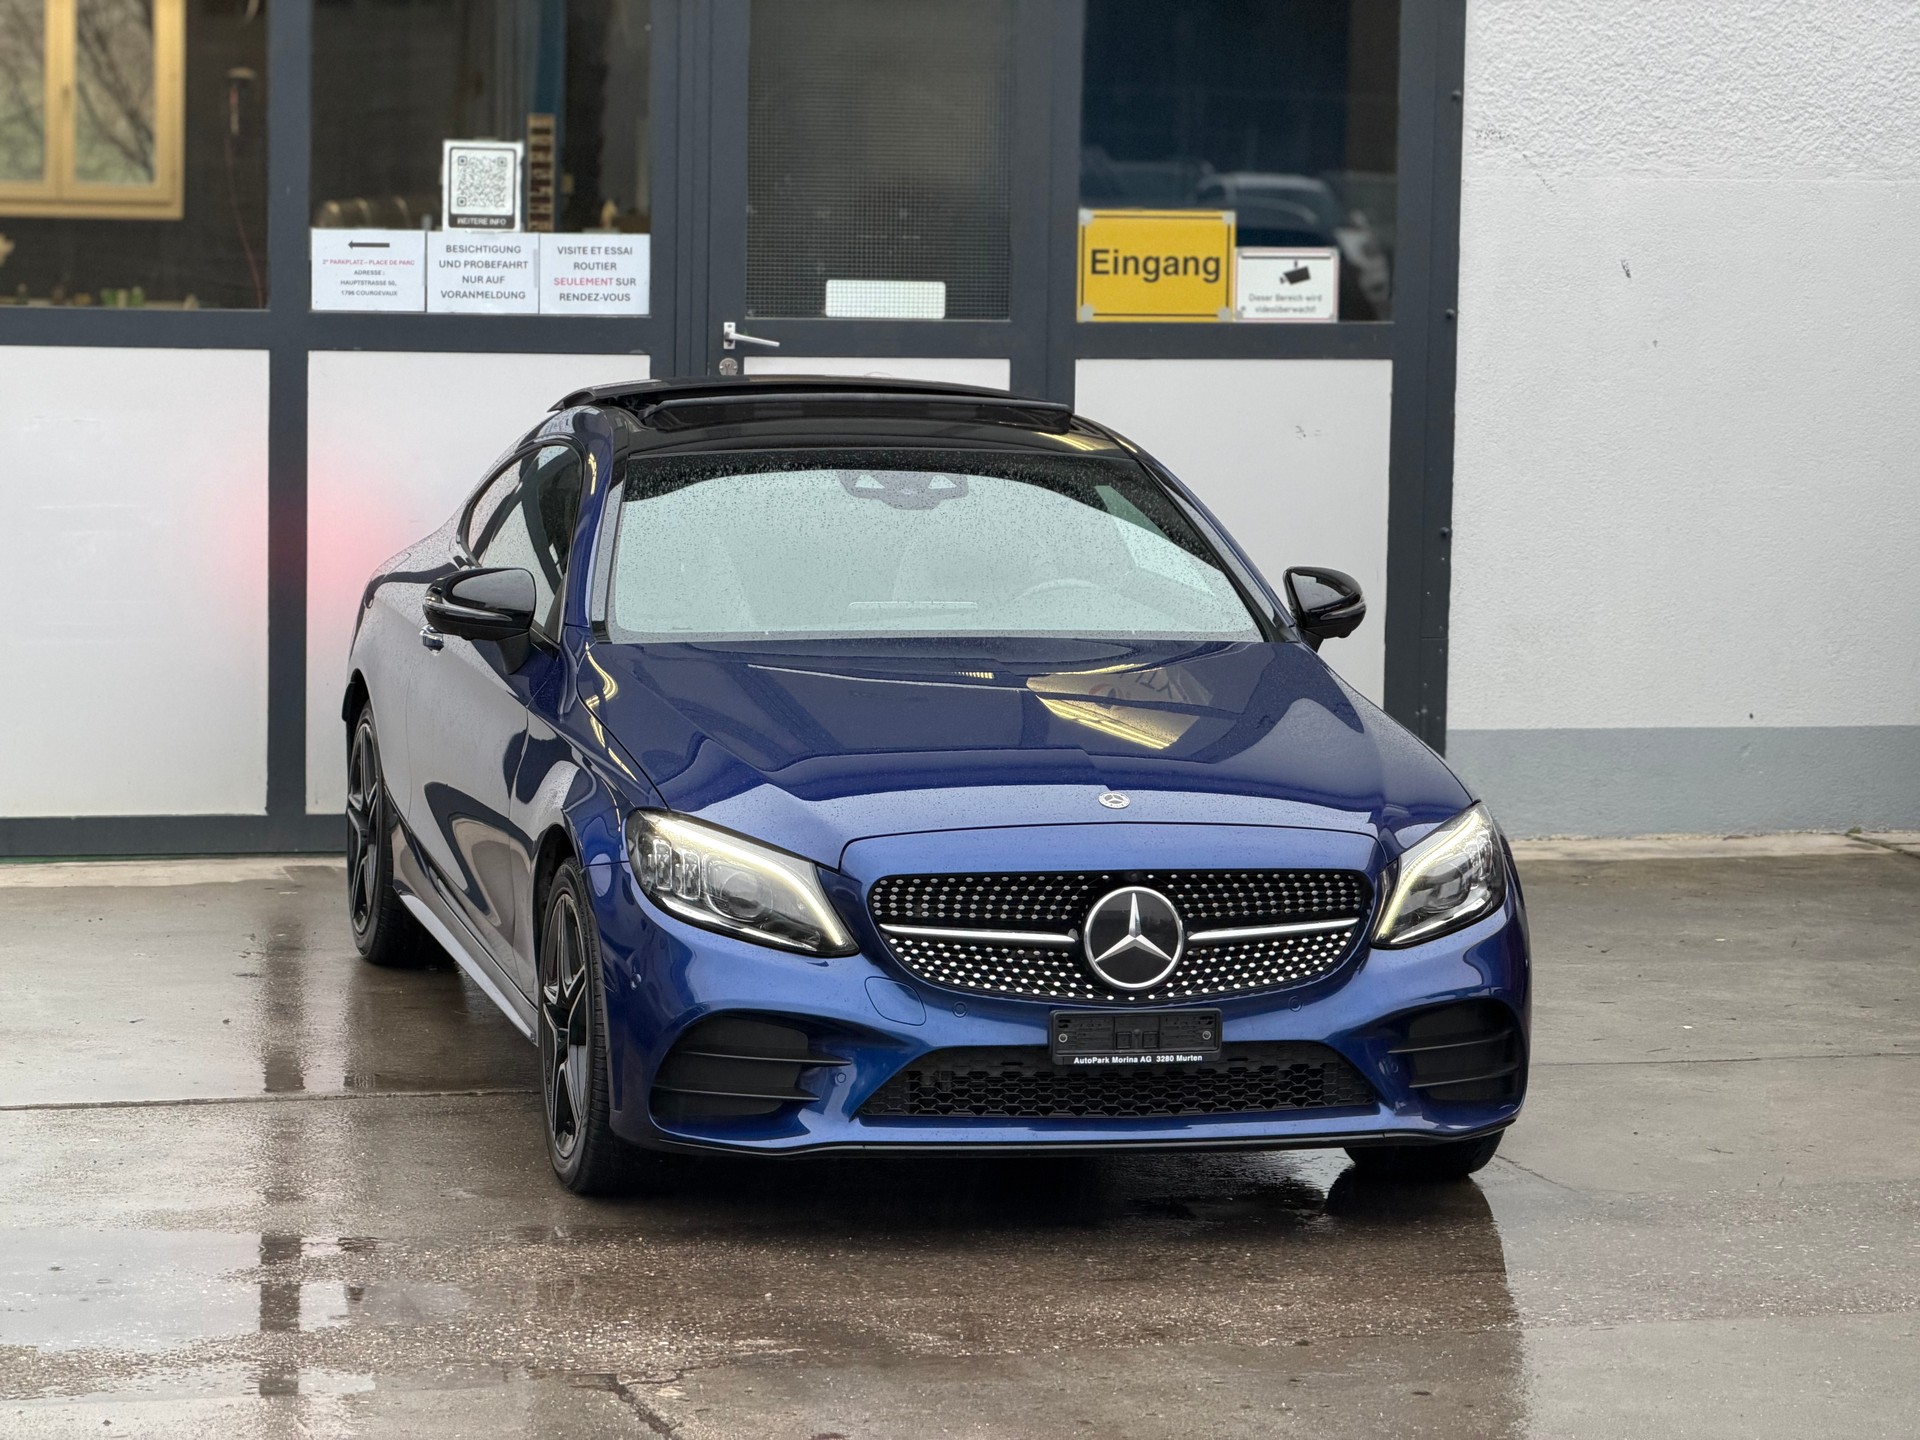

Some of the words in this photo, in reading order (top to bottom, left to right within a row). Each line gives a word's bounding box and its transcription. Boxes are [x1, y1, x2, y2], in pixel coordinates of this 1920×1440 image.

[446, 244, 522, 254] BESICHTIGUNG
[557, 246, 588, 255] VISITE
[590, 246, 602, 255] ET
[604, 246, 633, 255] ESSAI
[438, 260, 462, 269] UND
[463, 260, 529, 269] PROBEFAHRT
[573, 261, 618, 271] ROUTIER
[1090, 249, 1220, 284] Eingang
[462, 275, 484, 284] NUR
[485, 275, 506, 284] AUF
[553, 277, 613, 286] SEULEMENT
[615, 277, 637, 287] SUR
[440, 290, 526, 299] VORANMELDUNG
[559, 293, 631, 302] RENDEZ-VOUS
[1248, 293, 1273, 302] Dieser
[1275, 293, 1303, 302] Bereich
[1073, 1056, 1110, 1065] AutoPark
[1111, 1056, 1139, 1064] Morina
[1140, 1055, 1152, 1063] AG
[1155, 1055, 1175, 1063] 3280
[1176, 1054, 1203, 1062] Murten
